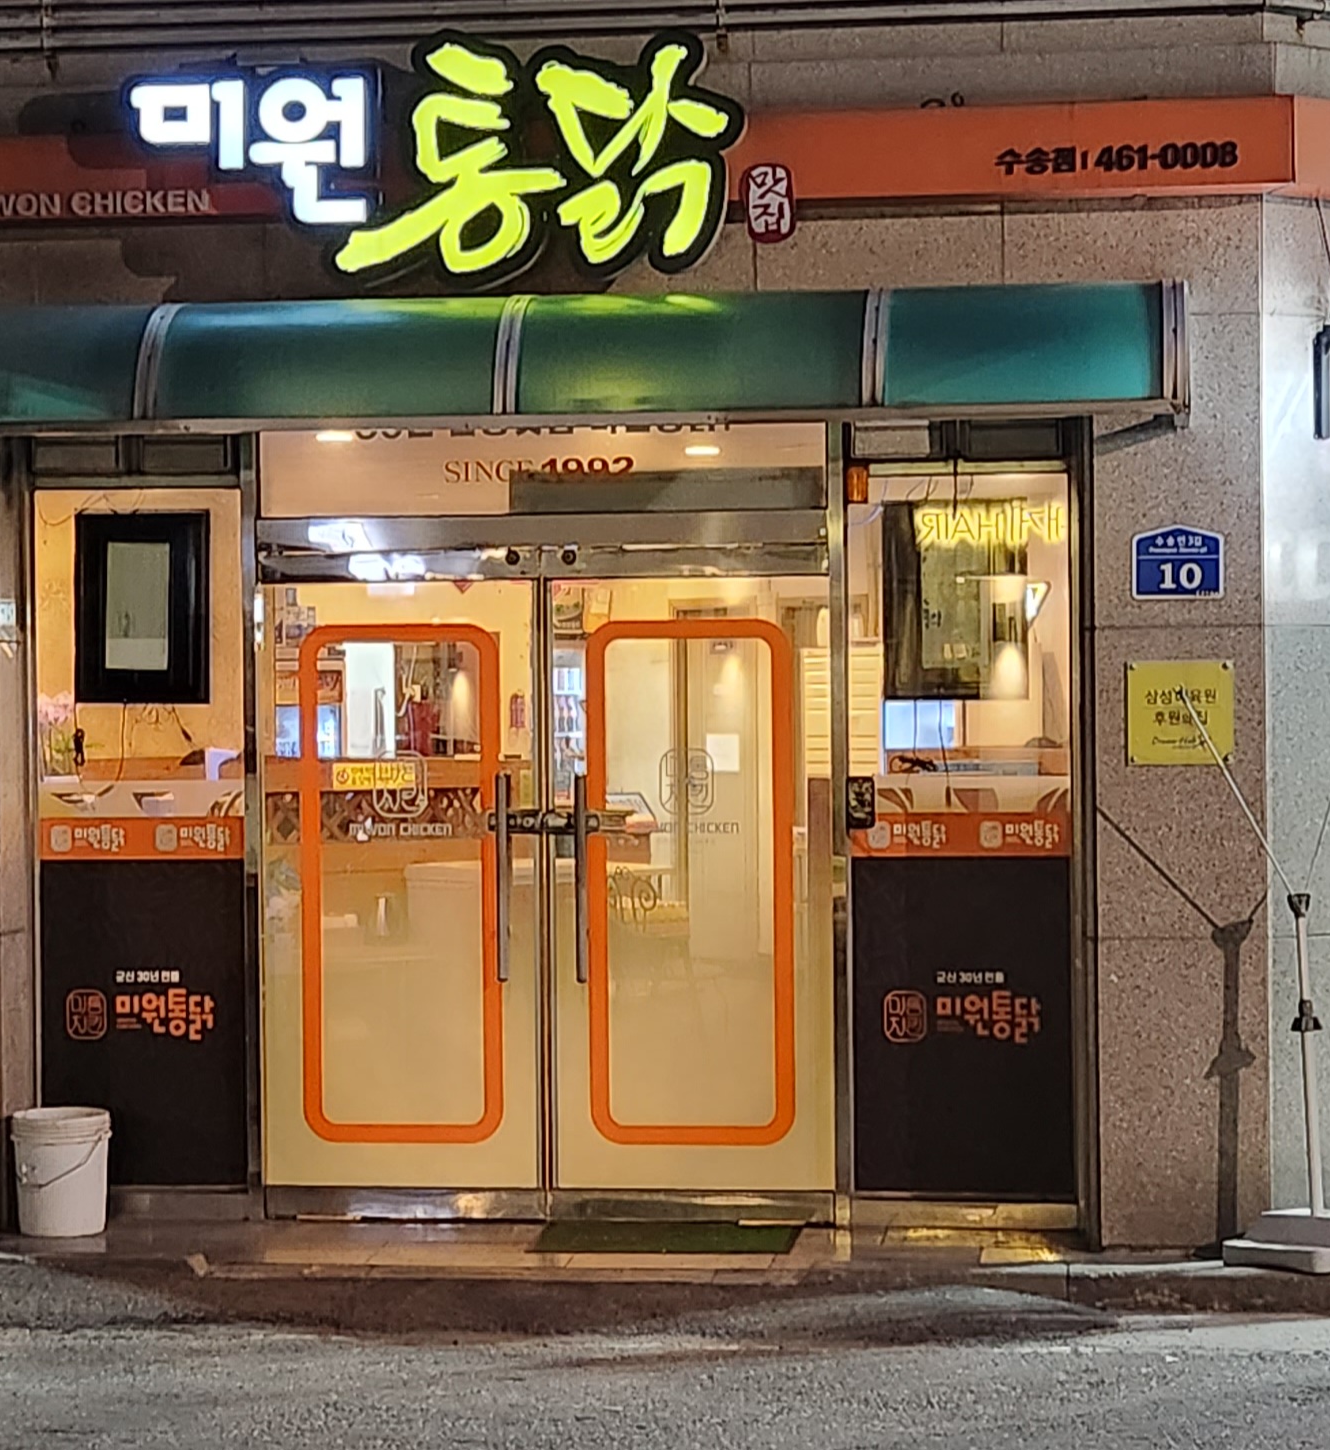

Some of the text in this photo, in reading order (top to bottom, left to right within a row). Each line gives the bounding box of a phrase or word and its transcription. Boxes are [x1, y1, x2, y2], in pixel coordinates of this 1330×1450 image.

[130, 43, 731, 273] 미원 통닭
[70, 189, 211, 215] CHICKEN
[749, 166, 789, 233] 맛집
[1159, 562, 1202, 590] 10
[400, 823, 452, 836] CHICKEN
[116, 988, 215, 1041] 미원통닭
[936, 989, 1041, 1044] 미원통닭
